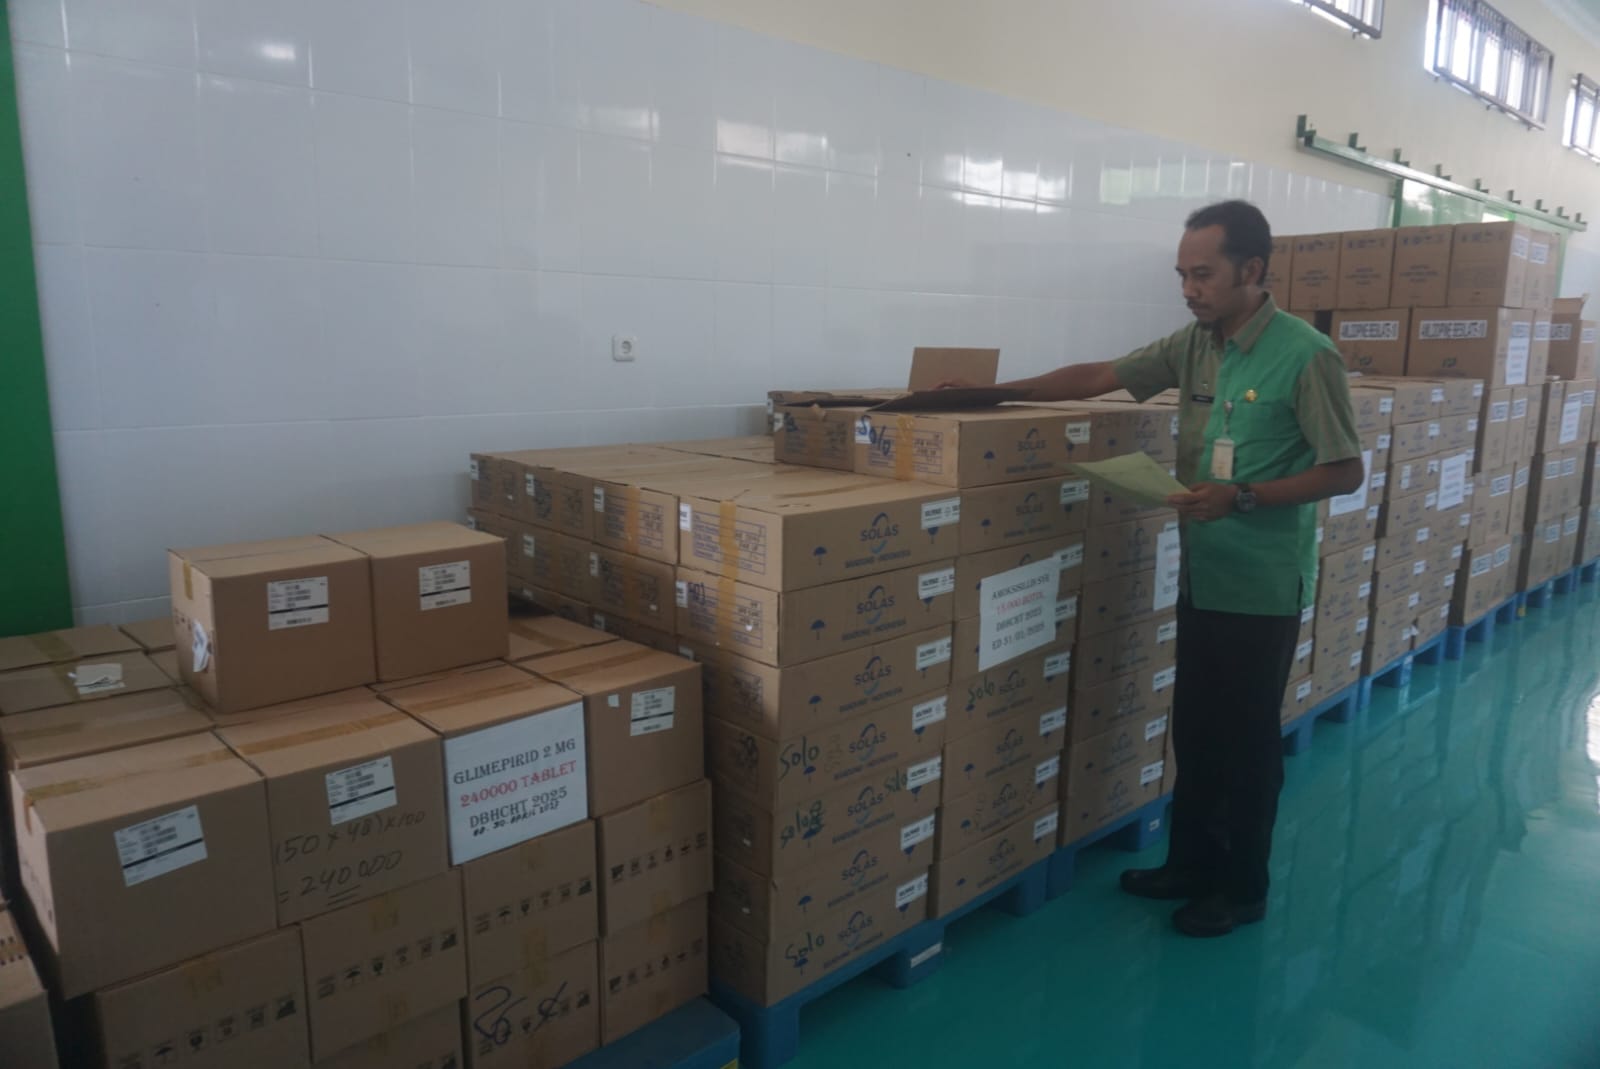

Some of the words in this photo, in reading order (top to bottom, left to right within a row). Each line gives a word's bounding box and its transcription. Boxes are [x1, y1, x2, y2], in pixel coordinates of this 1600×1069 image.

[859, 523, 900, 542] SOLAS
[856, 595, 896, 615] SOLAS
[854, 664, 893, 686] SOLAS
[848, 731, 888, 754] SOLAS
[453, 749, 540, 785] GLIMEPIRID
[542, 745, 553, 759] 2
[554, 738, 577, 756] MG
[777, 735, 820, 784] Solo
[460, 779, 518, 808] 240000
[520, 760, 577, 788] TABLET
[469, 799, 529, 829] DBHCHT
[531, 785, 568, 809] 2025
[848, 793, 884, 816] SOLAS
[840, 855, 881, 881] SOLAS
